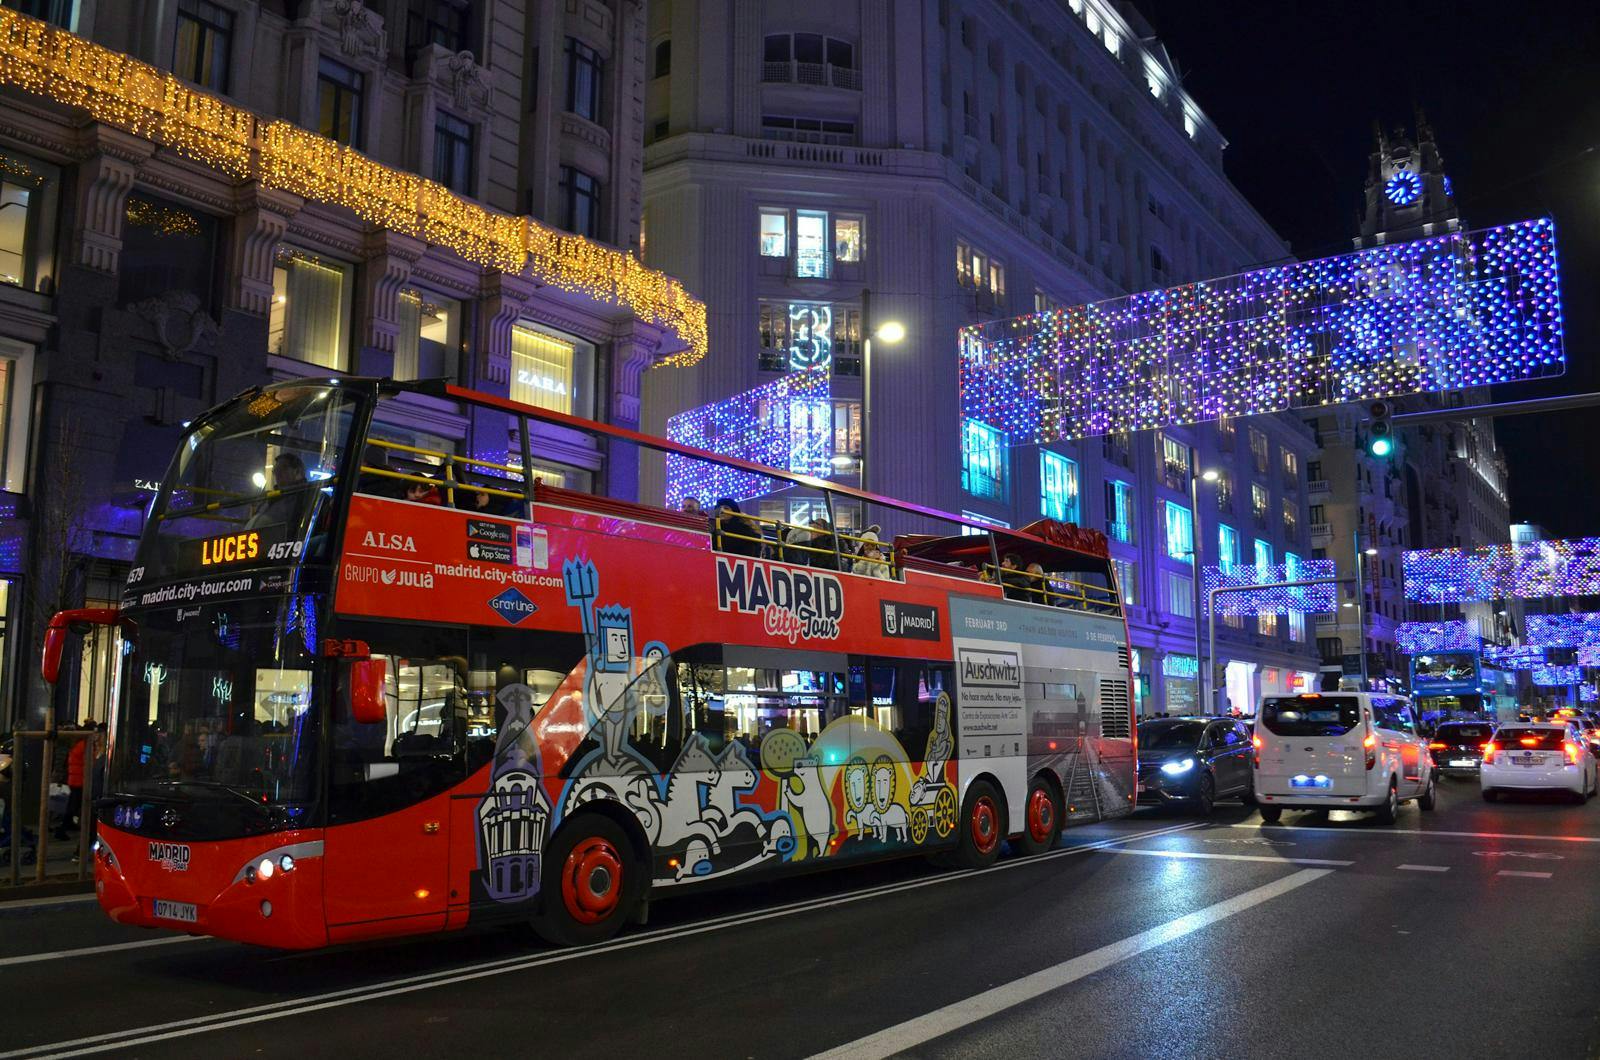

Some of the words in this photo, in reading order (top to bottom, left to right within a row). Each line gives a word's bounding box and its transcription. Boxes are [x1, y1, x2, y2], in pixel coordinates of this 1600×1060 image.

[518, 369, 567, 396] ZARA
[202, 532, 259, 565] LUCES
[267, 541, 303, 561] 4579
[362, 531, 418, 553] ALSA
[481, 549, 495, 560] App
[495, 550, 511, 560] Store
[345, 563, 379, 584] GRUPO
[435, 563, 564, 588] madrid.city-tour.com
[142, 576, 253, 606] madrid.city-tour.com
[716, 557, 844, 622] MADRID
[764, 603, 799, 644] City
[798, 605, 840, 640] Tour
[901, 610, 935, 634] ¡MADRID!
[965, 616, 994, 630] FEBRUARY
[996, 620, 1008, 631] 3RD
[965, 656, 1018, 681] Auschwitz
[149, 842, 191, 864] MADRID
[157, 902, 178, 917] 0714
[181, 905, 195, 921] JYK
